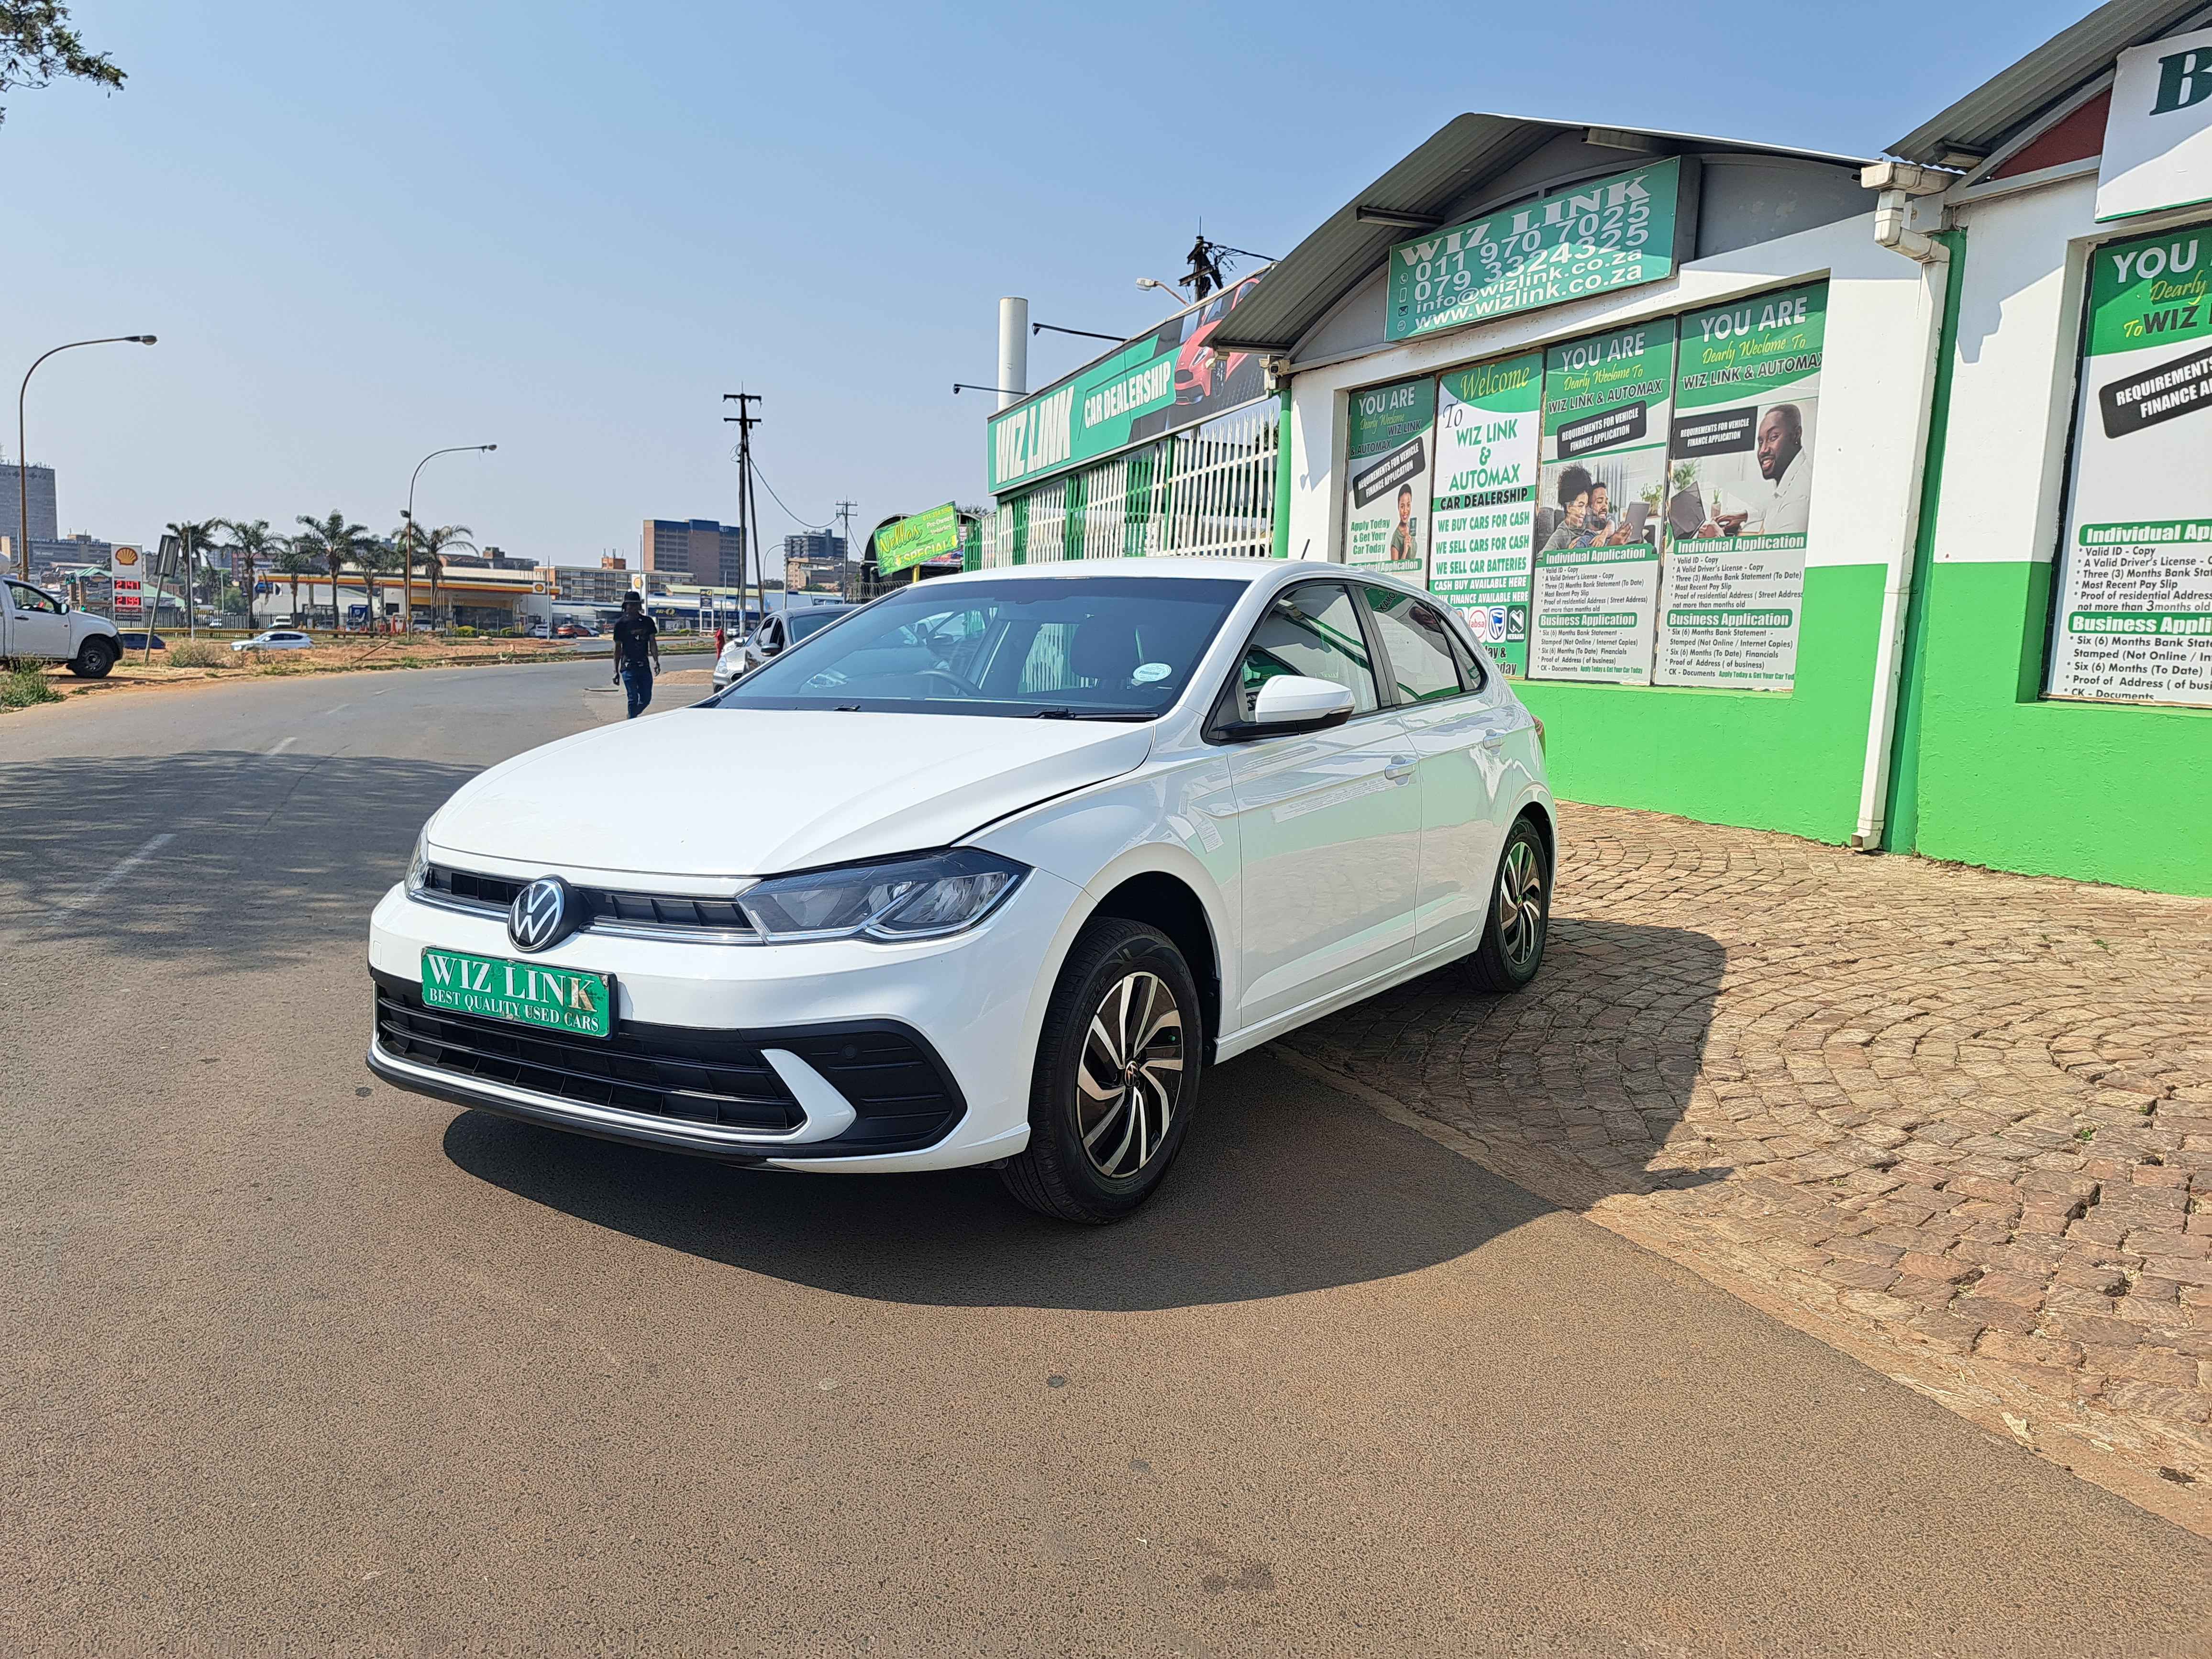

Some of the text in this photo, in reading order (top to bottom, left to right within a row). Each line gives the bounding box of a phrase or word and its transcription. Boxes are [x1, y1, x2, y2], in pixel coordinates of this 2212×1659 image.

[1399, 175, 1652, 266] WIZ LINK
[1415, 197, 1650, 282] 011 970 7025
[1415, 222, 1649, 301] 079 3324325
[2112, 239, 2199, 283] YOU
[1416, 249, 1642, 314] info@wizlink.co.za
[2150, 270, 2207, 305] Dearly
[1415, 264, 1642, 331] www.wizlink.co.za
[1700, 297, 1807, 343] YOU ARE
[2124, 306, 2200, 338] To WIZ
[1561, 332, 1645, 372] YOU ARE
[1703, 341, 1736, 368] Dearly
[1792, 334, 1806, 349] To
[1460, 364, 1529, 400] Welcome
[1564, 370, 1590, 395] Dearly
[1632, 364, 1643, 377] To
[1683, 373, 1707, 390] WIZ
[1711, 367, 1741, 386] LINK
[1745, 365, 1753, 379] &
[1084, 361, 1172, 429] CAR DEALERSHIP
[1359, 386, 1415, 416] YOU ARE
[1548, 380, 1662, 413] WIZ LINK & AUTOMAX
[2140, 385, 2198, 418] FINANCE
[1443, 400, 1463, 429] To
[1561, 408, 1639, 441] REQUIREMENTS FOR VEHICLE
[996, 385, 1074, 485] WIZ LINK
[1388, 420, 1421, 436] WIZ LINK
[1457, 418, 1518, 448] WIZ LINK
[1570, 424, 1630, 452] FINANCE APPLICATION
[1681, 418, 1749, 438] REQUIREMENTS FOR VEHICLE
[1687, 431, 1741, 447] FINANCE APPLICATION
[1350, 440, 1392, 455] & AUTOMAX
[1479, 446, 1491, 466] &
[1359, 442, 1419, 490] REQUIREMENTS FOR VEHICLE
[1449, 463, 1520, 492] AUTOMAX
[1366, 460, 1413, 498] FINANCE APPLICATION
[1440, 487, 1527, 510] CAR DEALERSHIP
[927, 516, 953, 528] Pre-Owned
[1351, 519, 1390, 531] Apply Today
[1438, 511, 1530, 532] WE BUY CARS FOR CASH
[1353, 531, 1386, 543] & Get Your
[1436, 535, 1529, 554] WE SELL CARS FOR CASH
[1678, 536, 1804, 553] Individual Application
[2087, 525, 2181, 543] Individual
[1353, 544, 1385, 554] Car Today
[1546, 548, 1646, 564] Individual Application
[2086, 547, 2122, 555] Valid ID
[1381, 560, 1417, 571] Application
[1436, 557, 1526, 575] WE SELL CAR BATTERIES
[2112, 569, 2124, 579] (3)
[2127, 569, 2161, 578] Months
[2165, 568, 2190, 577] Bank
[1435, 577, 1526, 591] CASH BUY AVAILABLE HERE
[1710, 583, 1719, 591] Pay
[1721, 582, 1732, 591] Slip
[2140, 580, 2157, 590] Pay
[2160, 580, 2178, 590] Slip
[1450, 594, 1476, 604] FINANCE
[1478, 593, 1510, 603] AVAILABLE
[1513, 591, 1528, 602] HERE
[1470, 619, 1485, 628] absa
[1540, 614, 1635, 626] Business Application
[1670, 613, 1789, 626] Business Application
[2072, 616, 2157, 631] Business
[1500, 647, 1506, 658] &
[2074, 662, 2202, 677] Six (6) Months (To Date)
[426, 954, 598, 1013] WIZ LINK
[430, 988, 599, 1032] BEST QUALITY USED CARS
